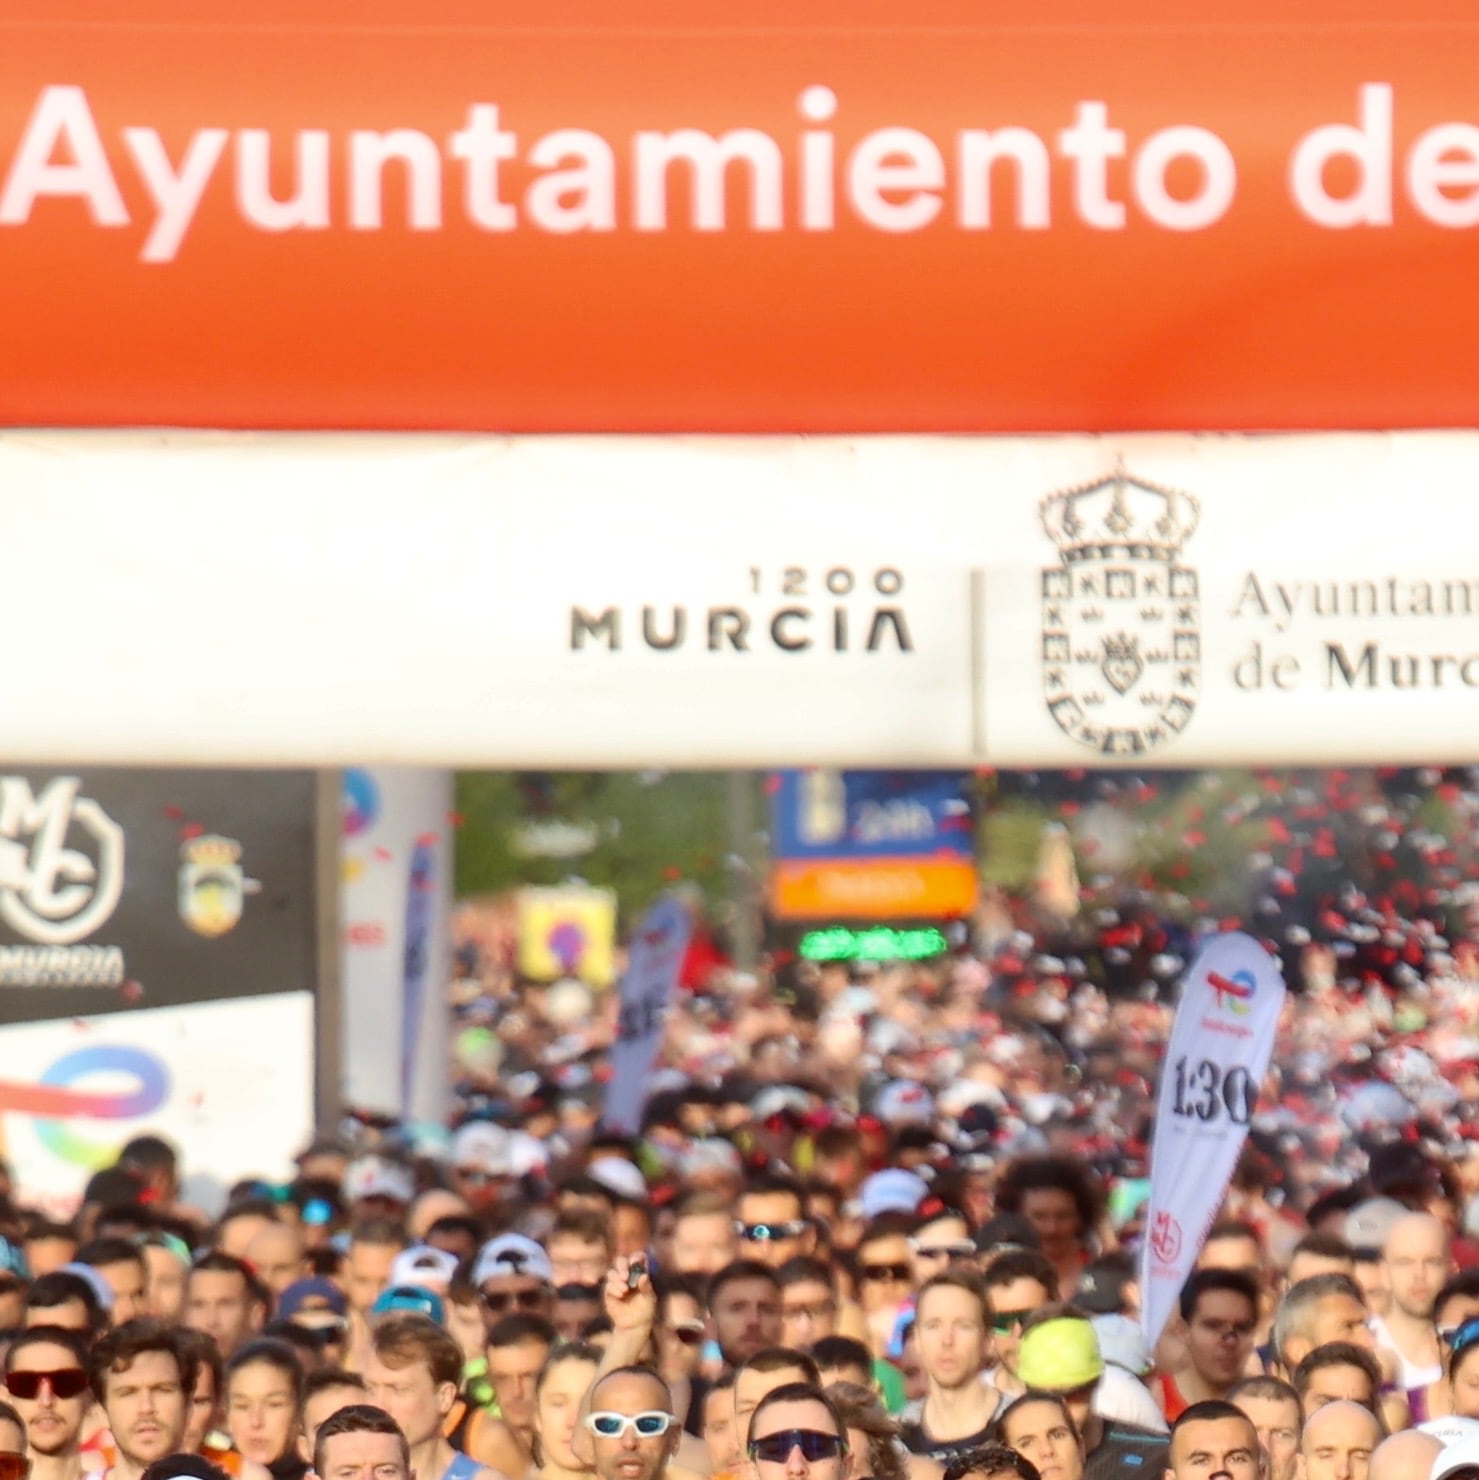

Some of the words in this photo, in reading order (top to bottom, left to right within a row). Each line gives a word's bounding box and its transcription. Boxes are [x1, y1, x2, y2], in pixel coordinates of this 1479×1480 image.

[748, 565, 904, 595] 1200
[1233, 640, 1301, 690] de
[1172, 1054, 1259, 1126] 1:30
